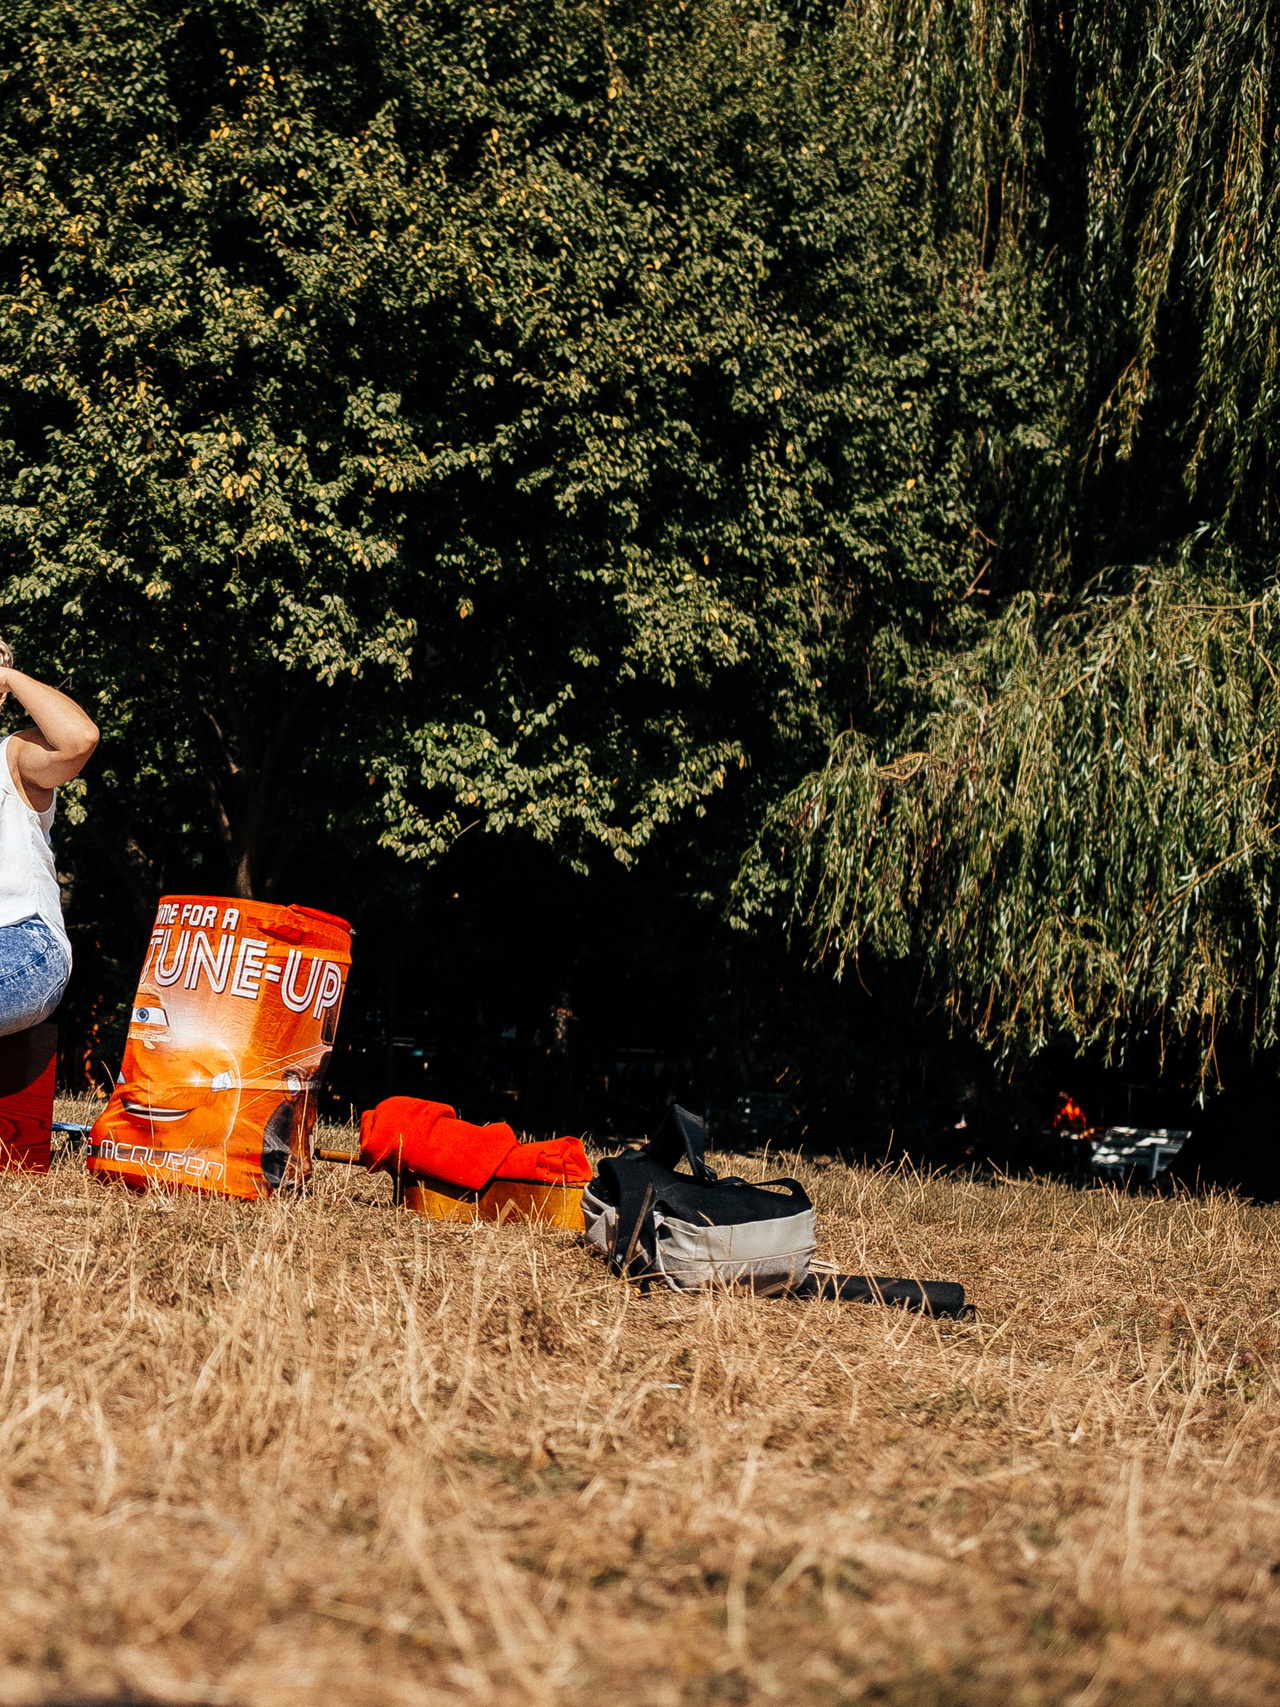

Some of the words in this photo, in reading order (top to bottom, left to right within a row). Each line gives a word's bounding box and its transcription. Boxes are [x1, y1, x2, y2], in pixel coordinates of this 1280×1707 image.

[180, 903, 219, 928] FOR
[221, 907, 240, 931] A
[140, 928, 342, 1020] TUNE-UP
